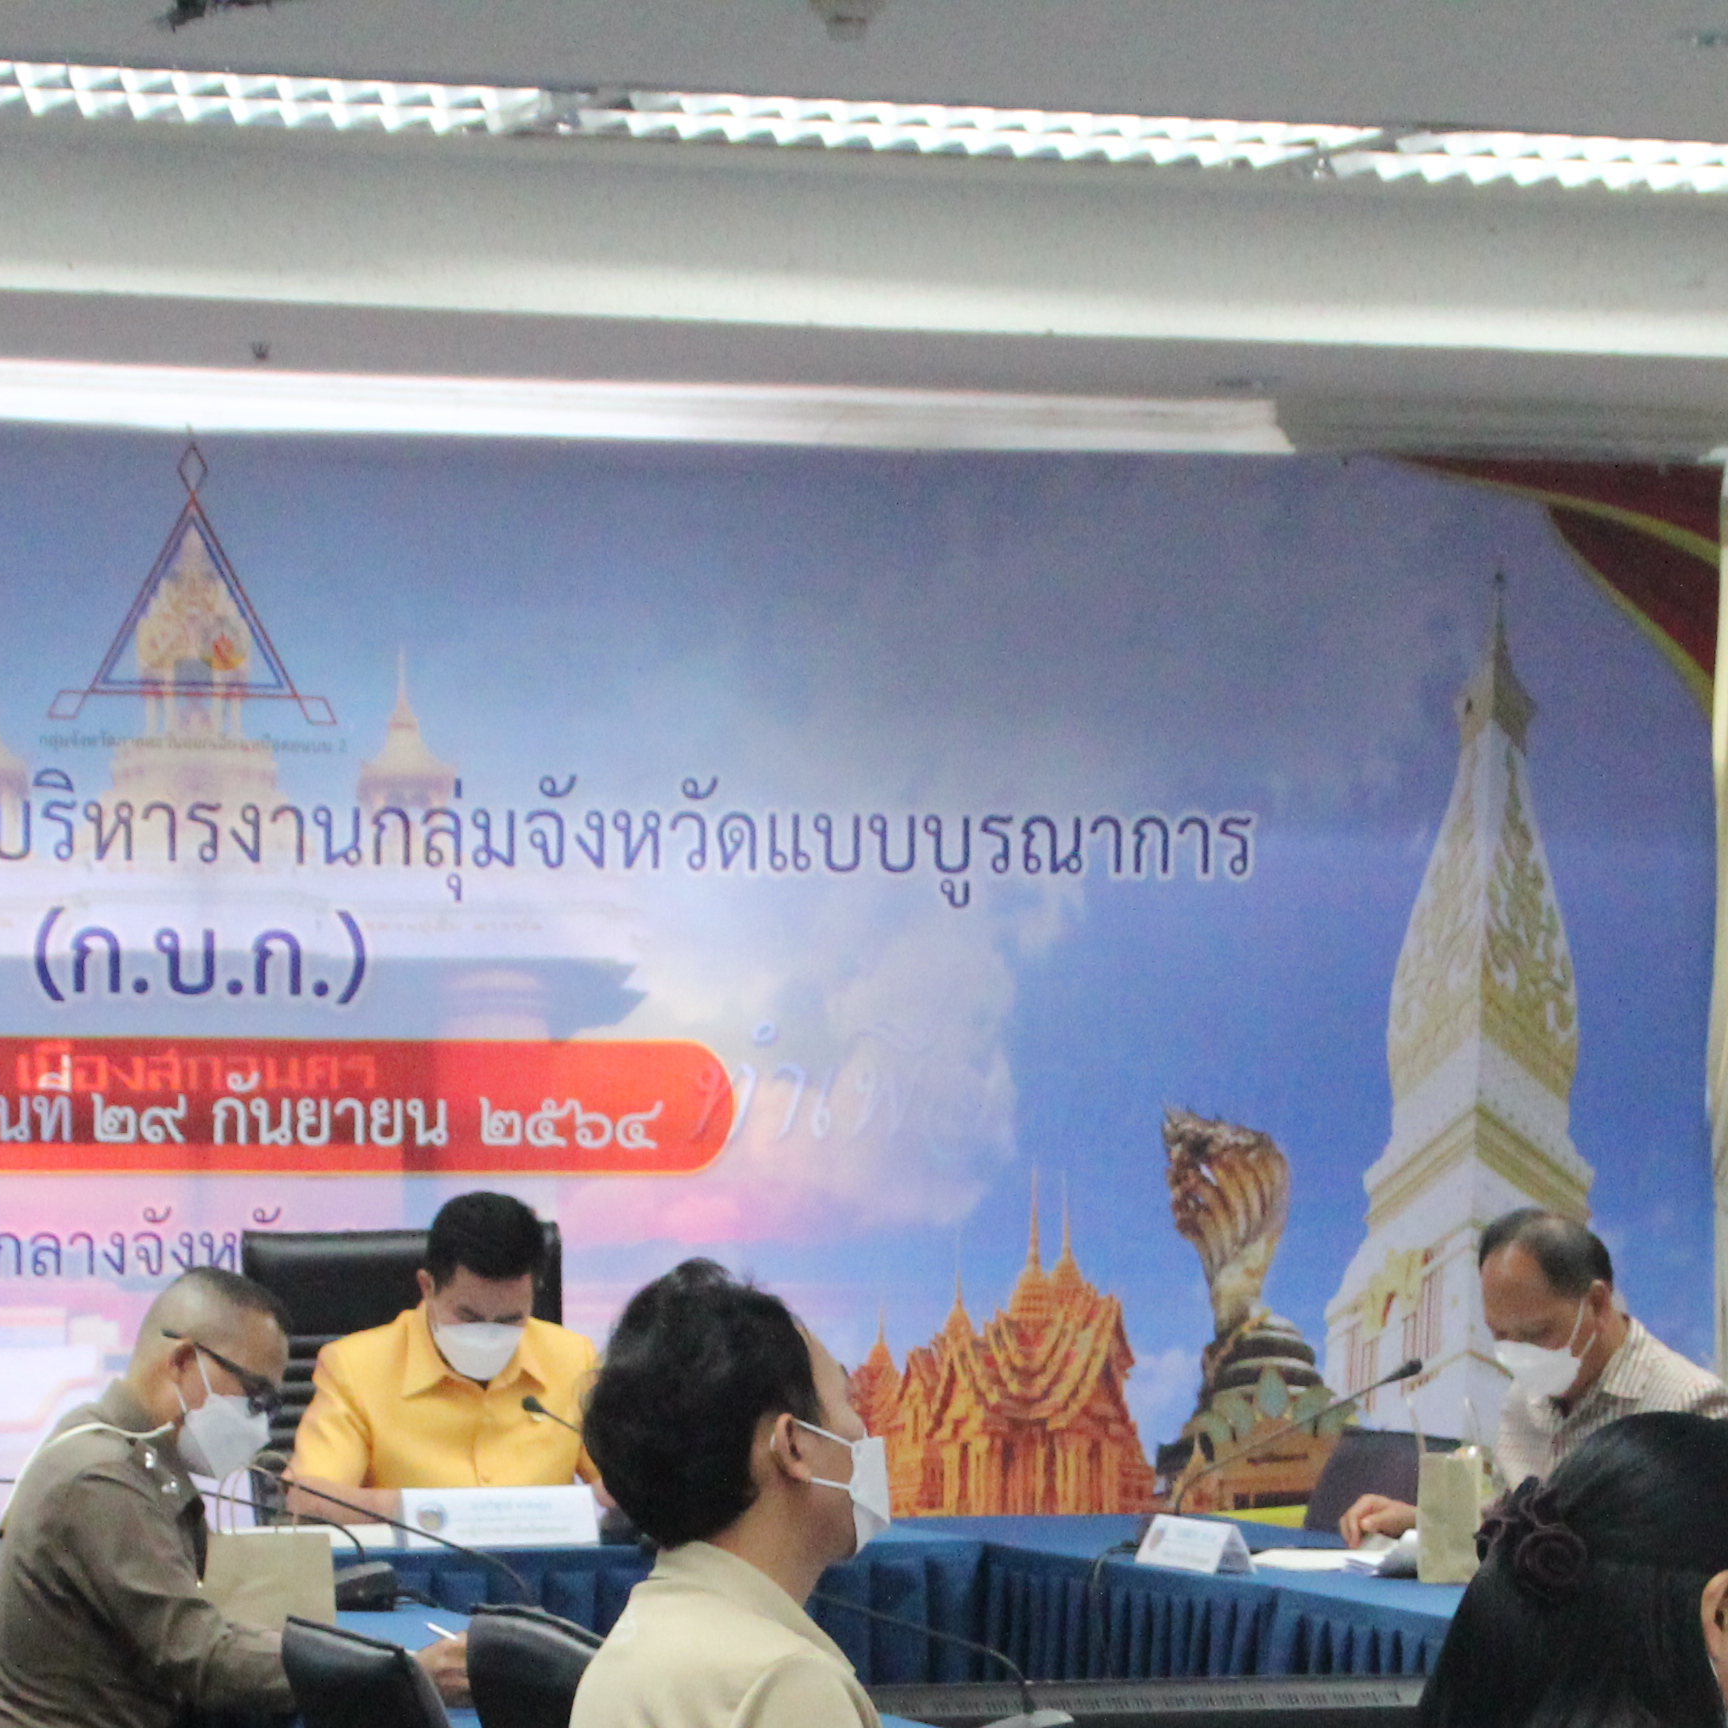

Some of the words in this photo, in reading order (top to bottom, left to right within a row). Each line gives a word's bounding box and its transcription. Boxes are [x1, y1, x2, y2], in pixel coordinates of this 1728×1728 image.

[34, 905, 368, 1004] (ก.บ.ก.)
[211, 1071, 448, 1148] กันยายน
[478, 1096, 664, 1151] ๒๕๖๔
